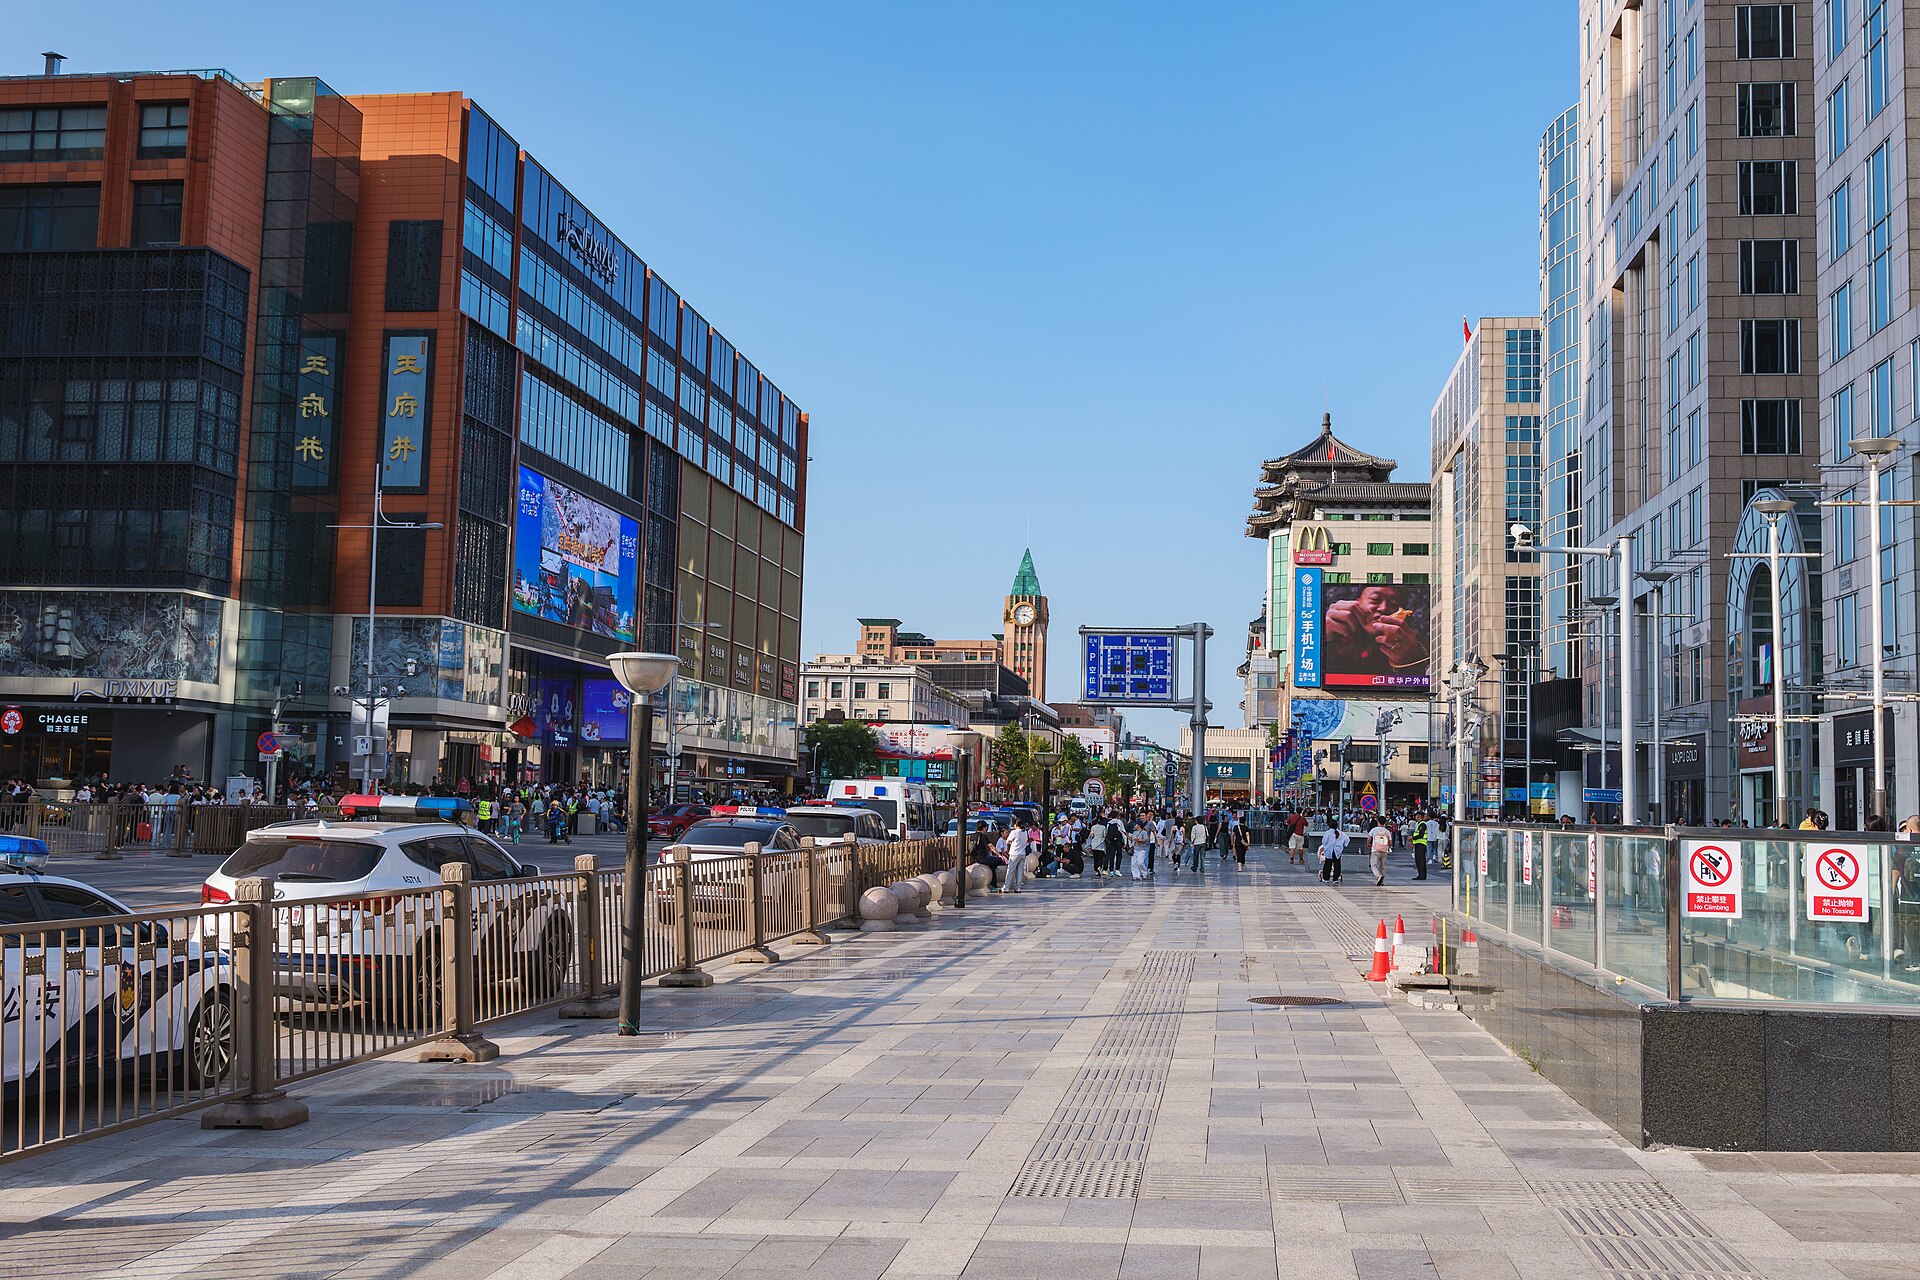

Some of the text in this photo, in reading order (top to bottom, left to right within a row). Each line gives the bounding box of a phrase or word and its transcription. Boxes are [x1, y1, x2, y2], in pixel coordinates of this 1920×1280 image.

[389, 354, 424, 462] 王府井
[1301, 620, 1314, 670] 手机广场
[1089, 652, 1096, 661] P
[1089, 665, 1096, 684] 空位
[38, 714, 88, 724] CHAGEE
[46, 725, 79, 733] 霸王茶姬
[1671, 750, 1698, 763] LAOPU GOLD
[402, 875, 422, 884] A5714
[1696, 895, 1727, 904] 禁止攀登
[1822, 899, 1854, 907] 禁止抛物
[1704, 904, 1729, 912] Climbing
[1832, 907, 1855, 915] Tossing
